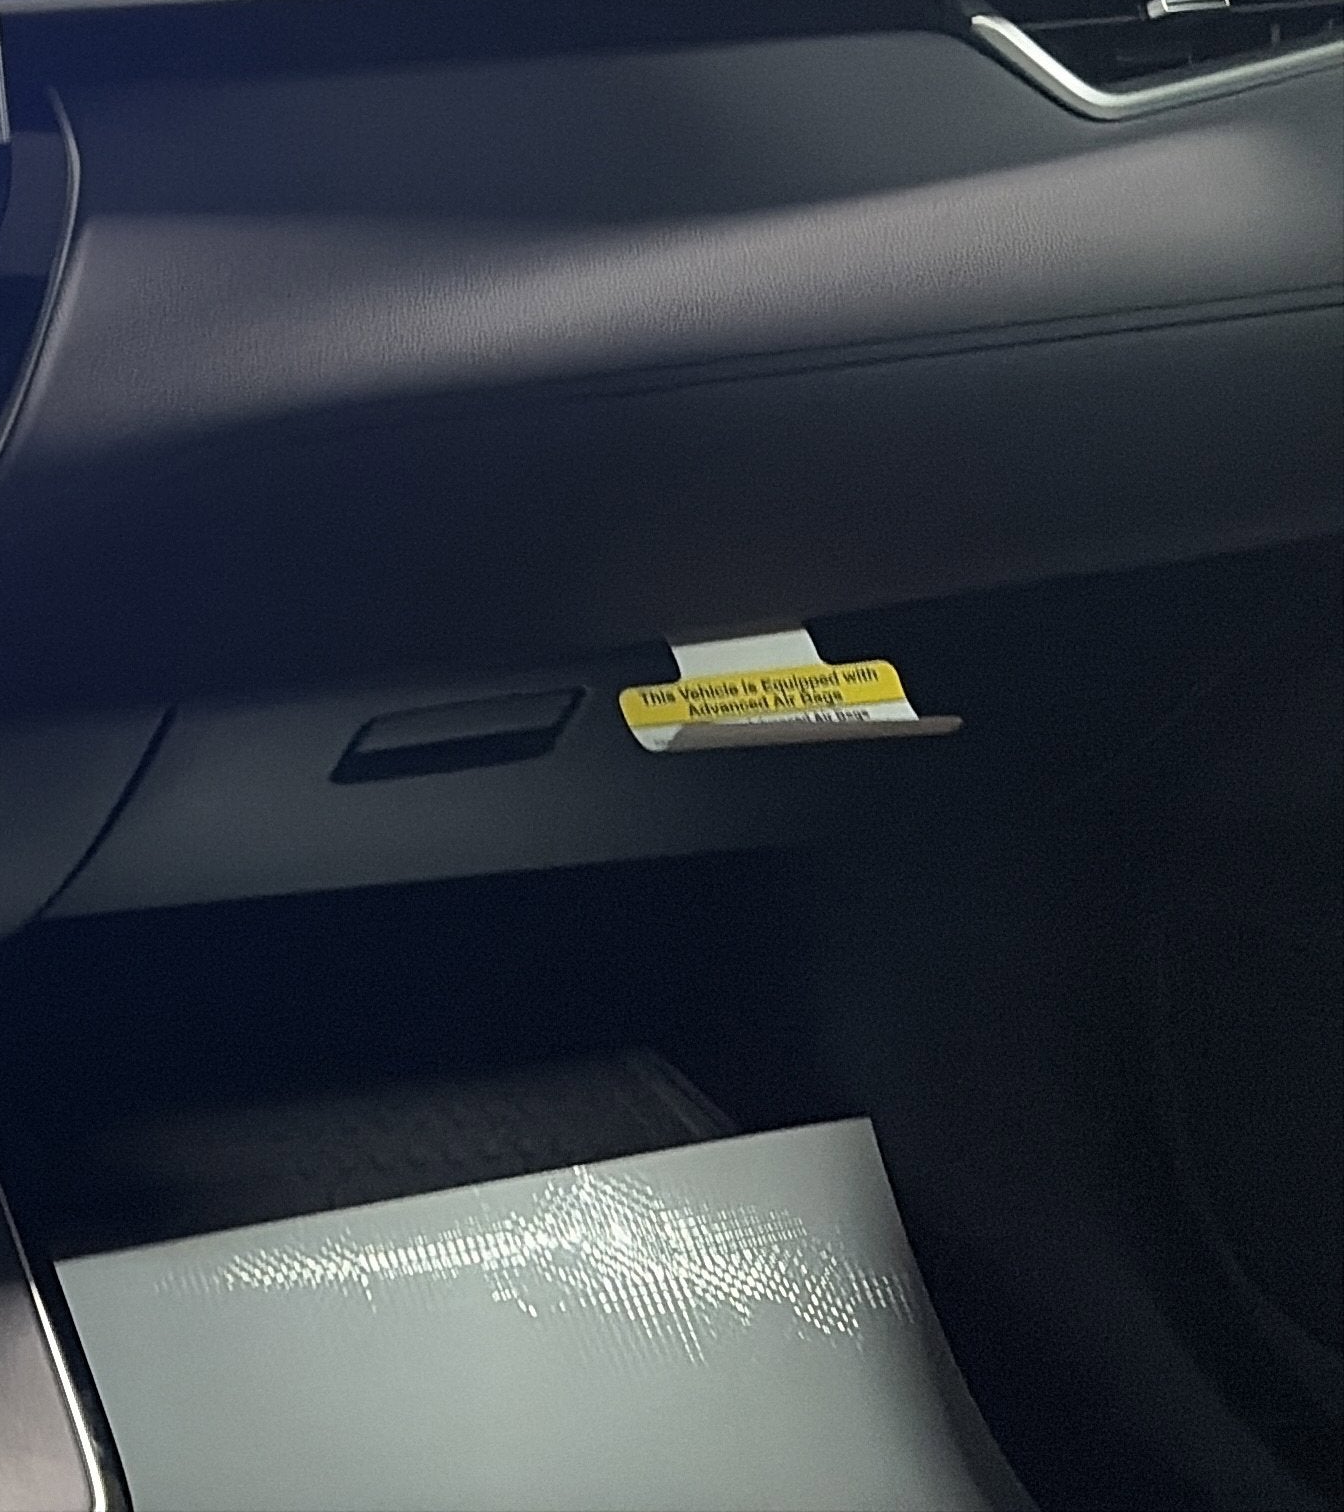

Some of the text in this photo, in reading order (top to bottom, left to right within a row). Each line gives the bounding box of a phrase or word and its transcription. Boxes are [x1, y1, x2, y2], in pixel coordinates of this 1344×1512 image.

[641, 690, 675, 707] This
[679, 683, 739, 700] Vehicle
[761, 671, 839, 694] Equipped
[842, 666, 879, 683] with
[688, 688, 844, 717] Advanced Air Bags
